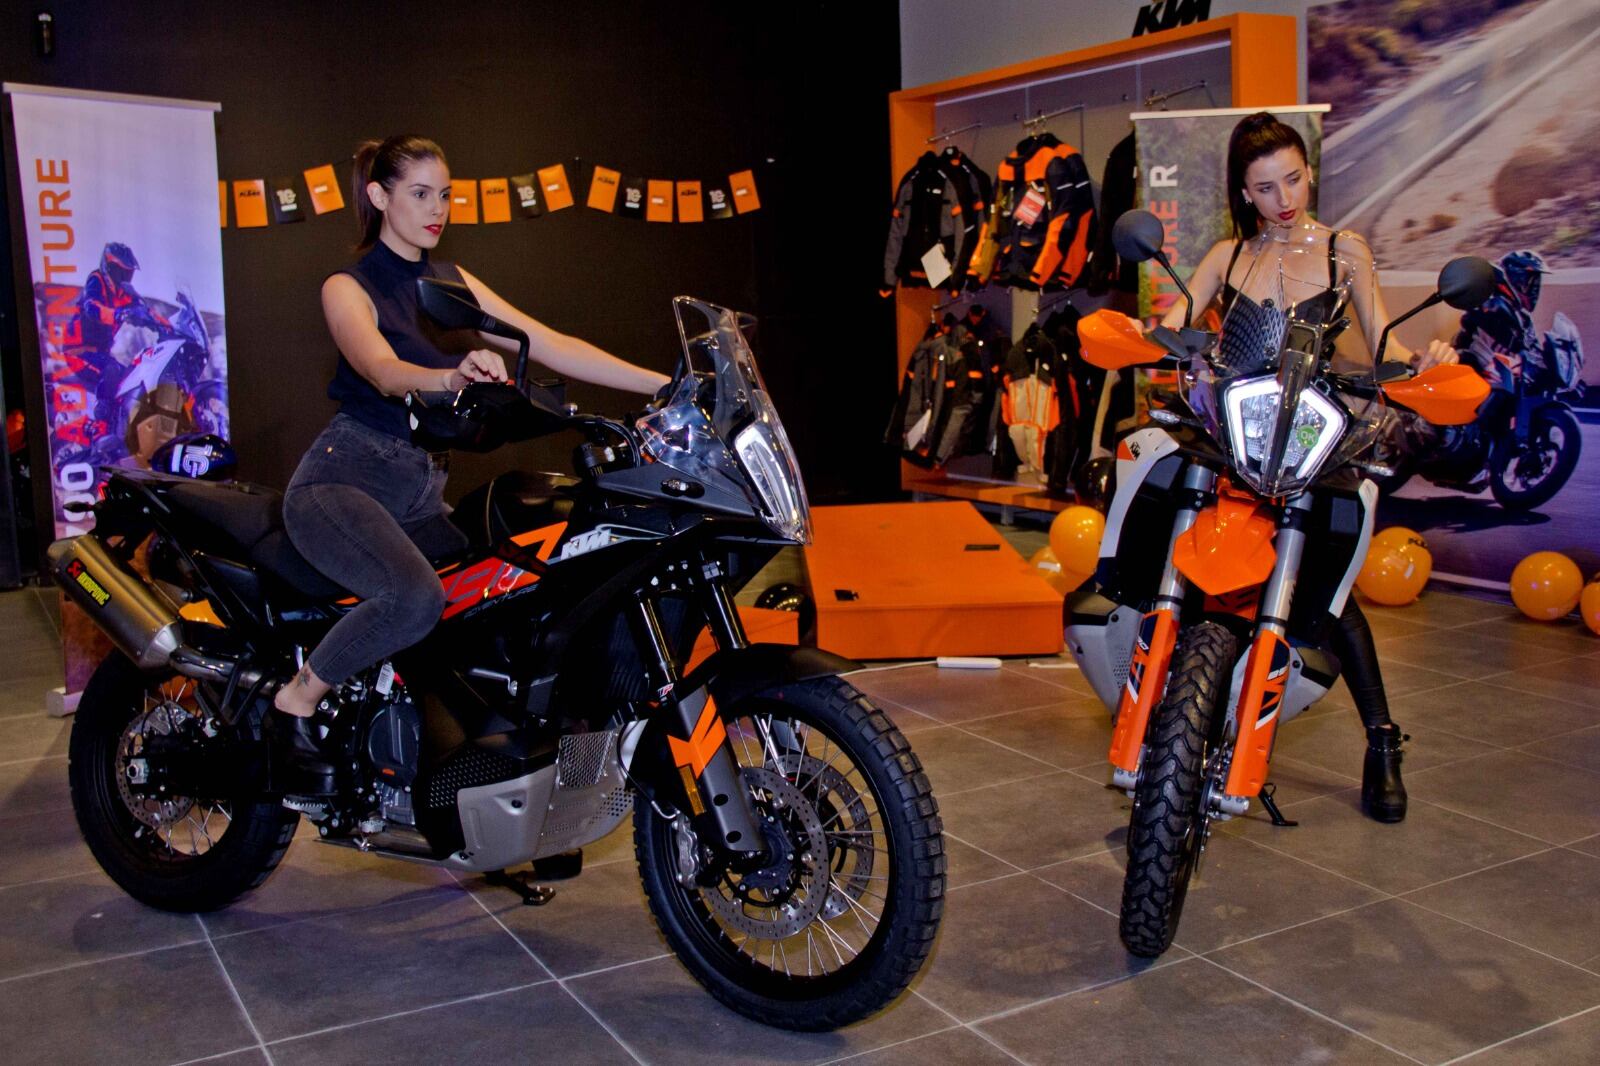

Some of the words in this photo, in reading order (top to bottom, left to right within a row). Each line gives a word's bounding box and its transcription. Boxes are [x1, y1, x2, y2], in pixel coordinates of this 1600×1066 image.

[1150, 163, 1179, 188] R
[35, 158, 91, 446] ADVENTURE
[560, 528, 612, 561] KTM
